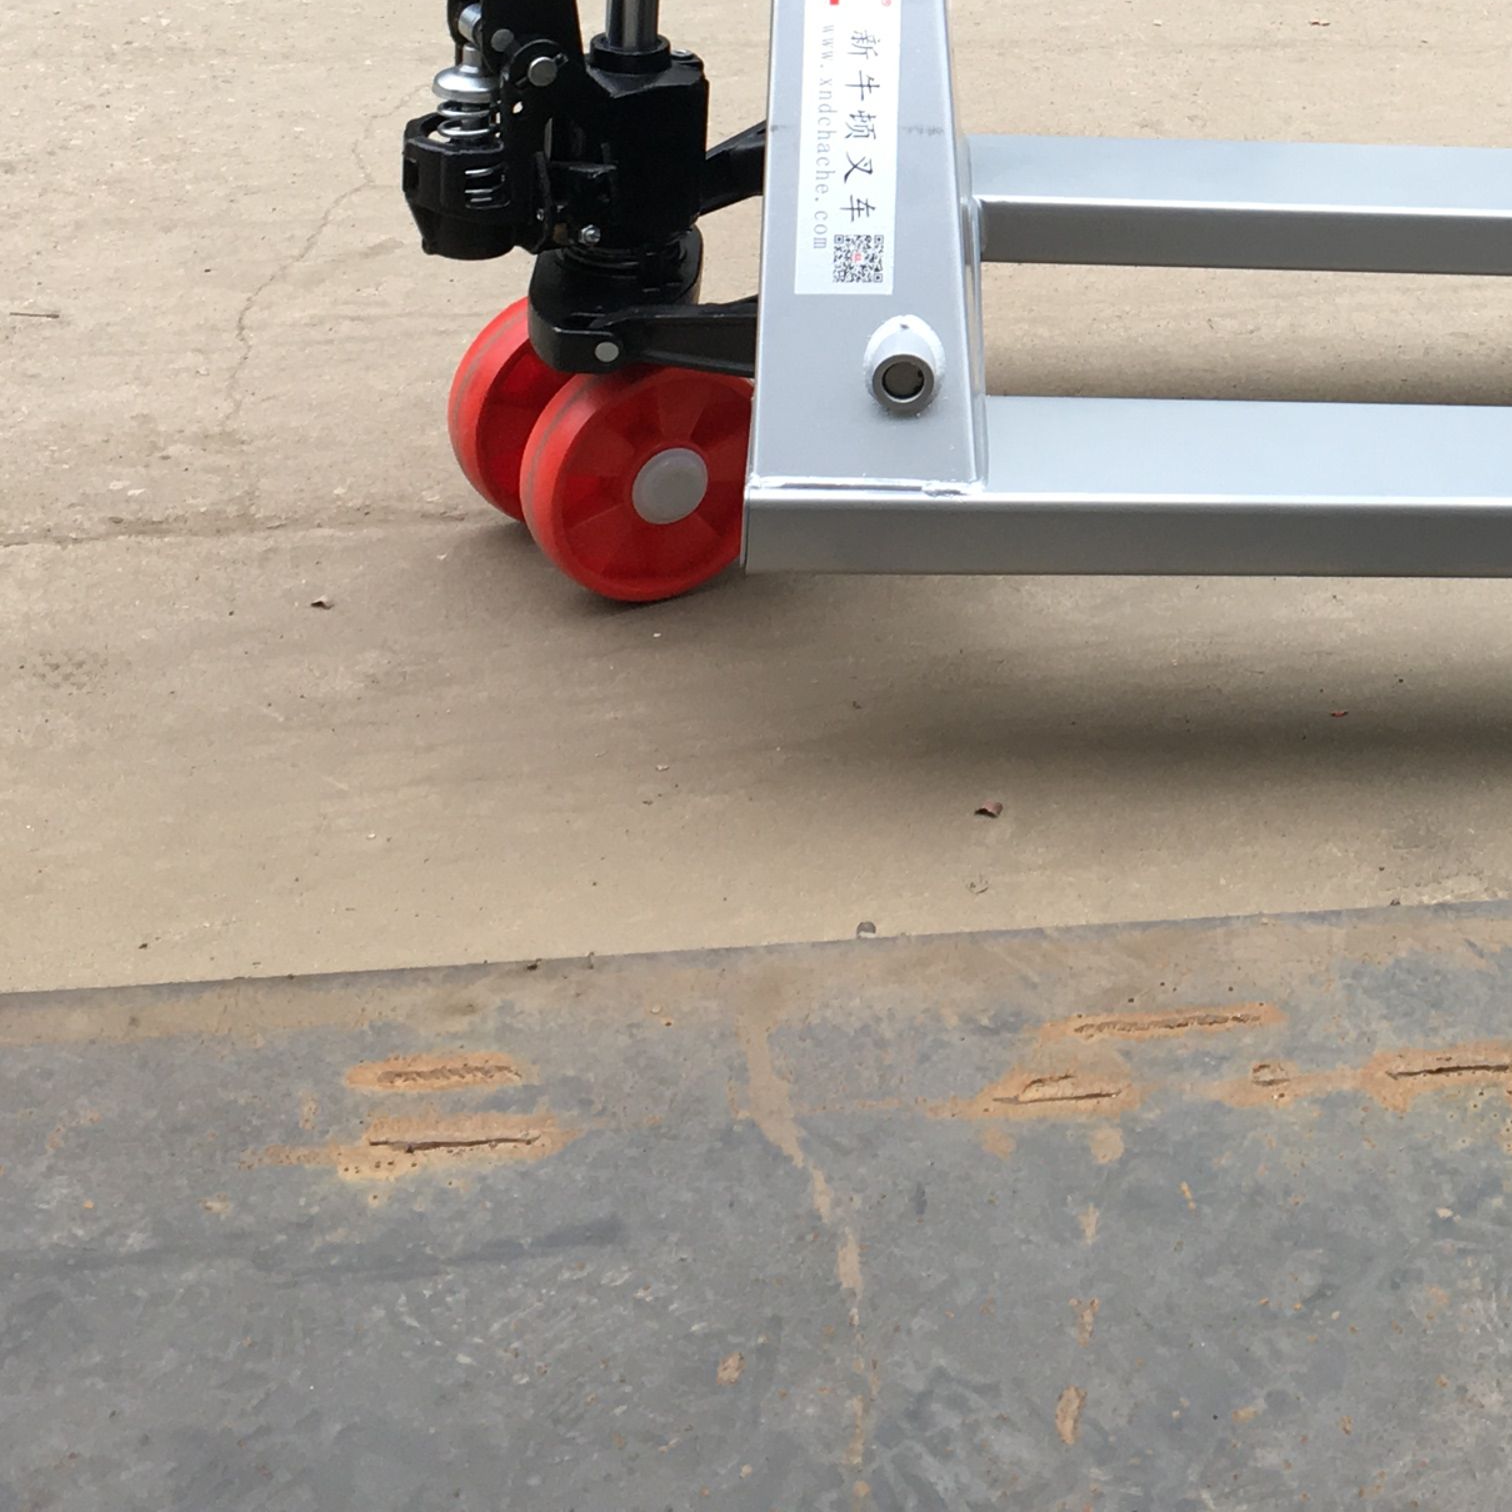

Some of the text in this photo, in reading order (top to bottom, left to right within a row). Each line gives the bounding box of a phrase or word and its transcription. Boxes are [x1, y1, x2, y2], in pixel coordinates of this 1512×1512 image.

[813, 25, 838, 249] www.xndchache.com
[840, 29, 881, 222] 新牛顿叉车
